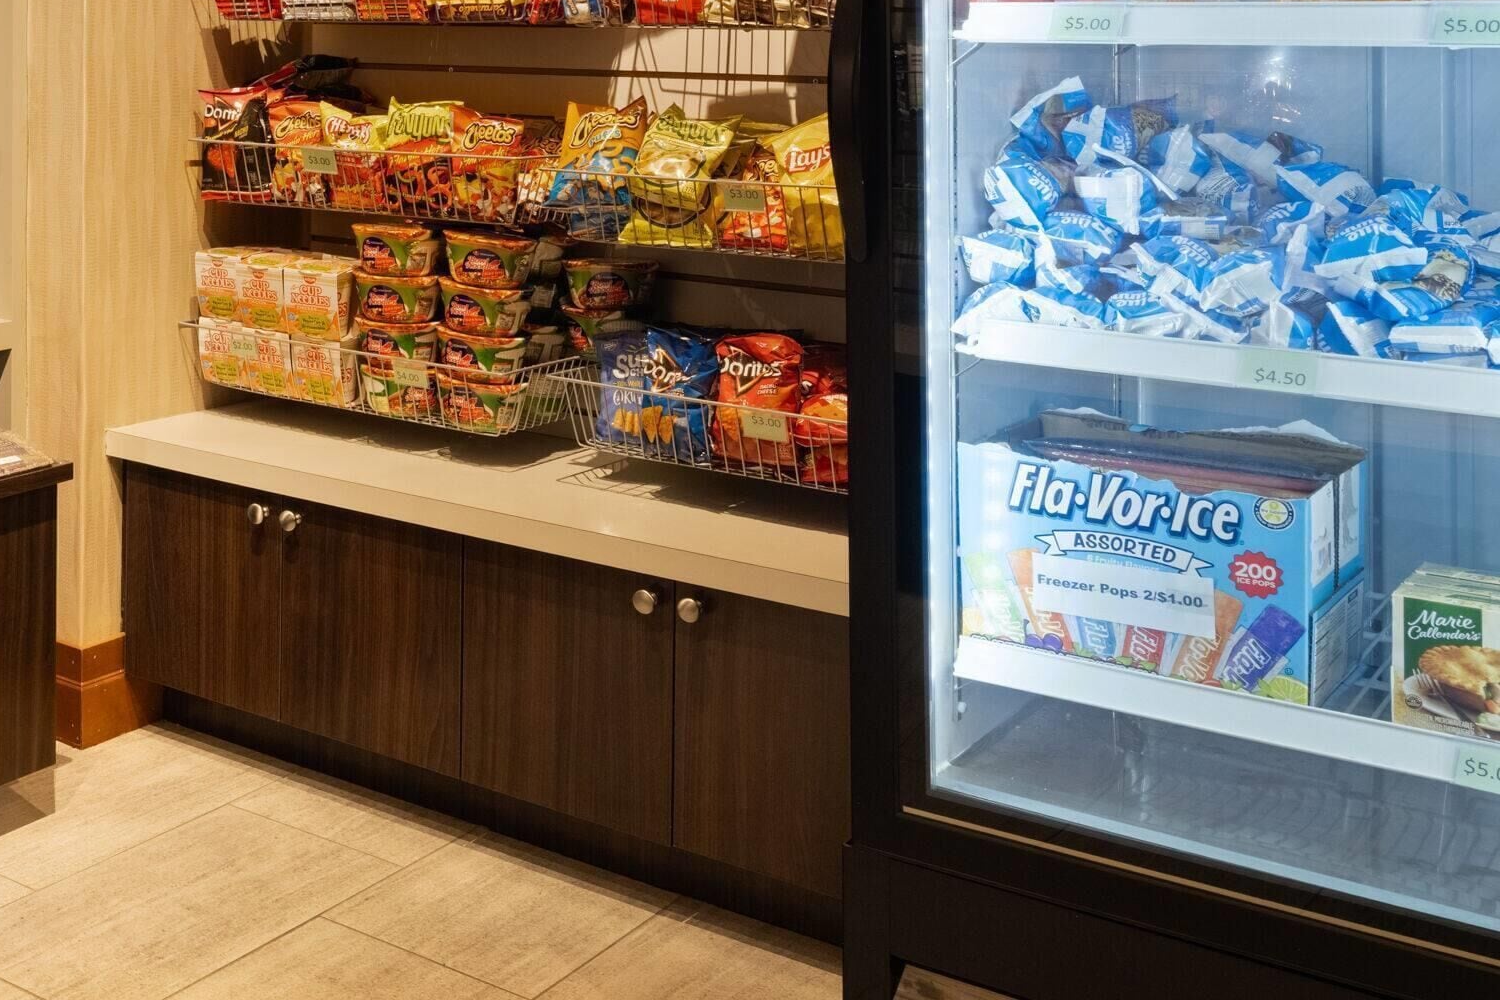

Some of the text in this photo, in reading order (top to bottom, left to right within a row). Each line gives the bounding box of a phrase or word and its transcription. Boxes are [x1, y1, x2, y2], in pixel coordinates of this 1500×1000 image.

[1065, 15, 1111, 31] $5.00
[1444, 18, 1500, 34] $5.00
[308, 156, 330, 166] $3.00
[729, 188, 759, 200] $3.00
[210, 267, 229, 279] CUP
[251, 279, 270, 291] CUP
[300, 285, 323, 297] CUP
[291, 292, 331, 308] NOODLES
[233, 340, 253, 351] $2.00
[397, 371, 420, 382] $4.00
[1254, 367, 1306, 387] $4.50
[751, 415, 782, 429] $3.00
[1073, 531, 1177, 564] ASSORTED
[1235, 561, 1277, 582] 200
[1037, 573, 1204, 608] Freezer Pops 2/$1.00
[1236, 577, 1276, 589] ICE POPS
[1407, 609, 1476, 629] Marie
[1407, 625, 1481, 641] Callender's
